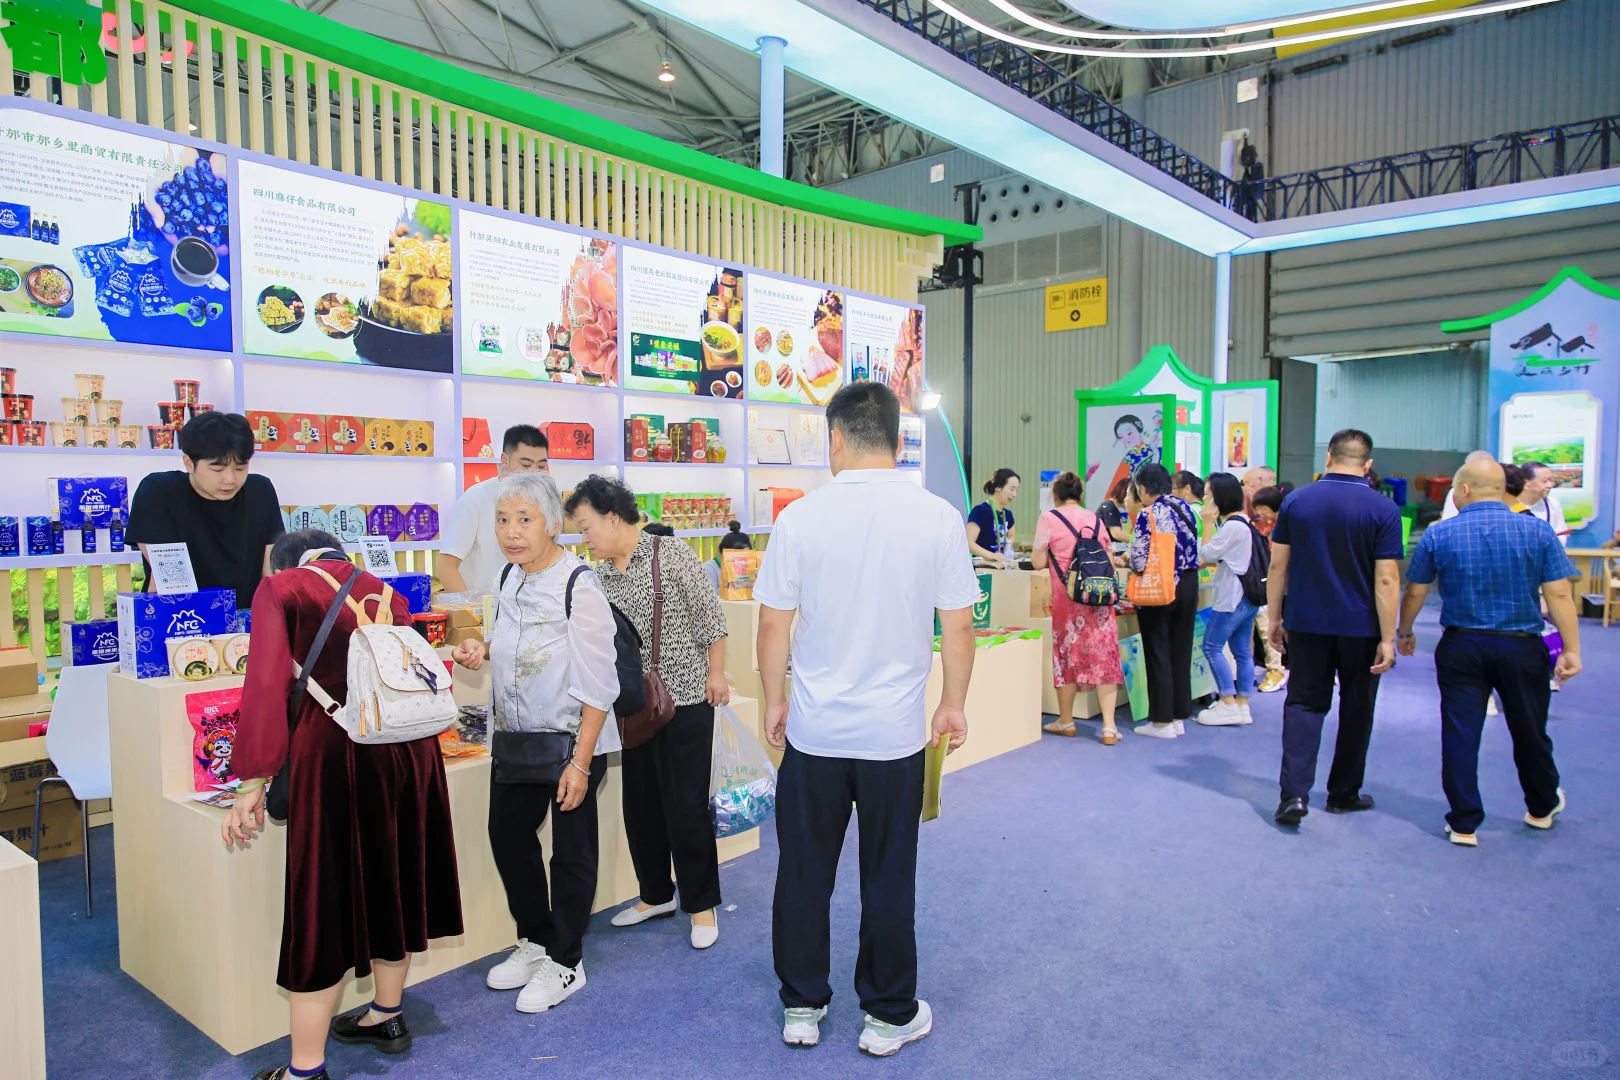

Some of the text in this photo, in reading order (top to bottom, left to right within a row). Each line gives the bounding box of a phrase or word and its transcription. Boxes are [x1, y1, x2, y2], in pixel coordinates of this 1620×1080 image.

[1068, 285, 1102, 301] 消防栓
[176, 620, 199, 631] NFC
